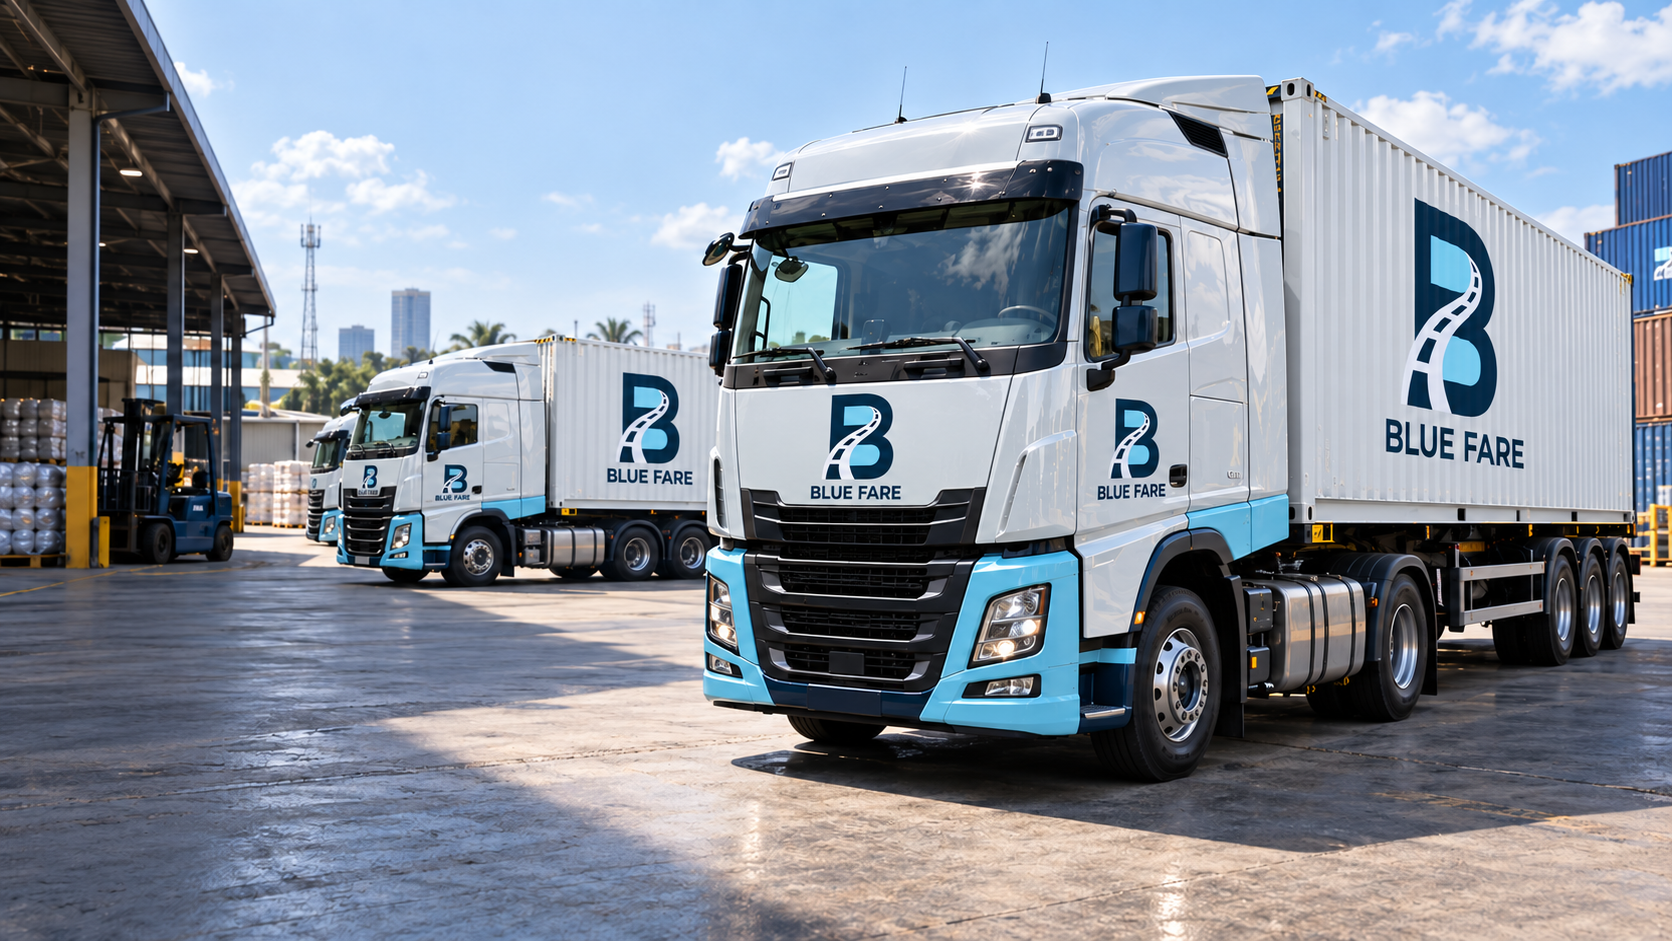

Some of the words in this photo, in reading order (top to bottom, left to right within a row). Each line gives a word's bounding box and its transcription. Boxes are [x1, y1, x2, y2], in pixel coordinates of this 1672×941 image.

[1385, 418, 1456, 460] BLUE
[1464, 431, 1525, 470] FARE
[606, 468, 649, 484] BLUE
[653, 469, 693, 486] FARE
[434, 494, 453, 502] BLUE
[810, 485, 853, 500] BLUE
[858, 485, 902, 500] FARE
[1097, 485, 1131, 501] BLUE
[1134, 484, 1166, 499] FARE
